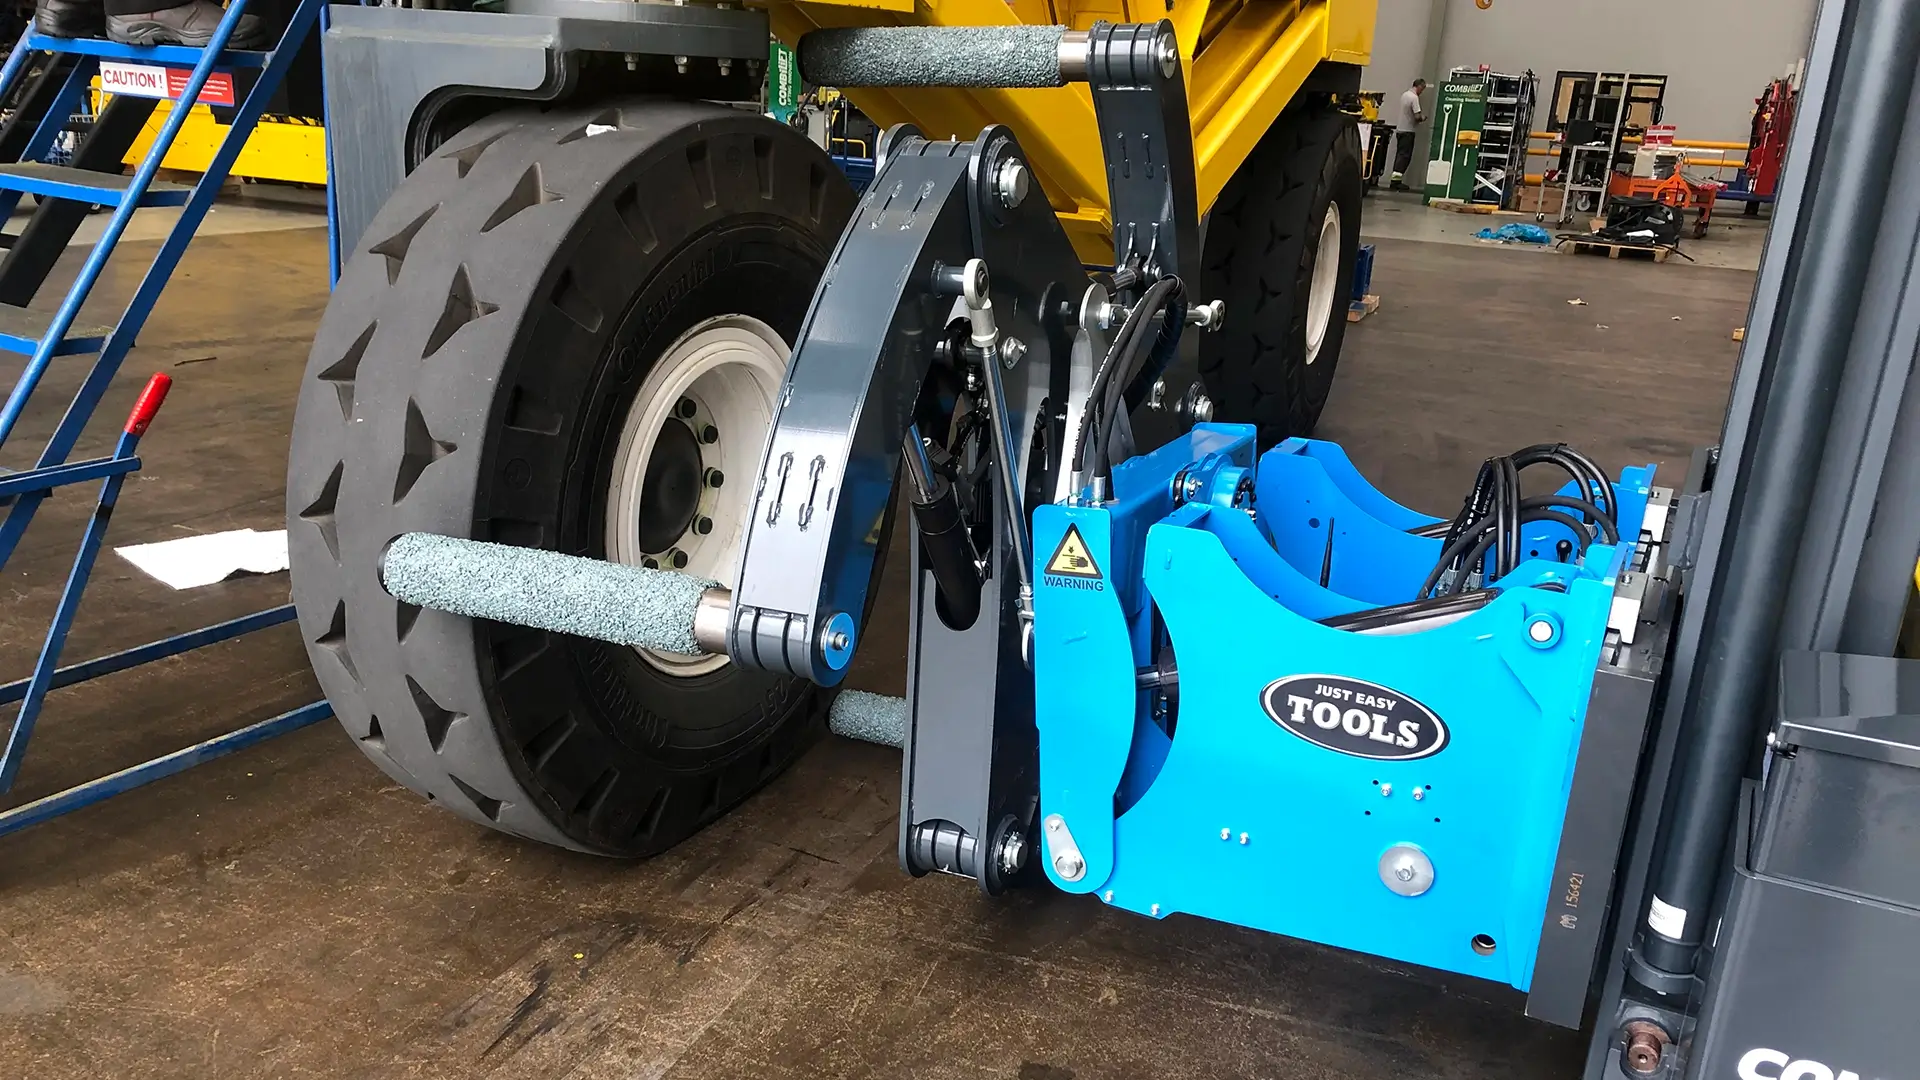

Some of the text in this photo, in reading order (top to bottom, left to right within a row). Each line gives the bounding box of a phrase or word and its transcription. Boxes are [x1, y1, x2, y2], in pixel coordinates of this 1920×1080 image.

[103, 69, 157, 89] CAUTION
[1043, 575, 1104, 592] WARNING
[1315, 683, 1397, 711] JUST EASY
[1287, 694, 1421, 749] TOOLS
